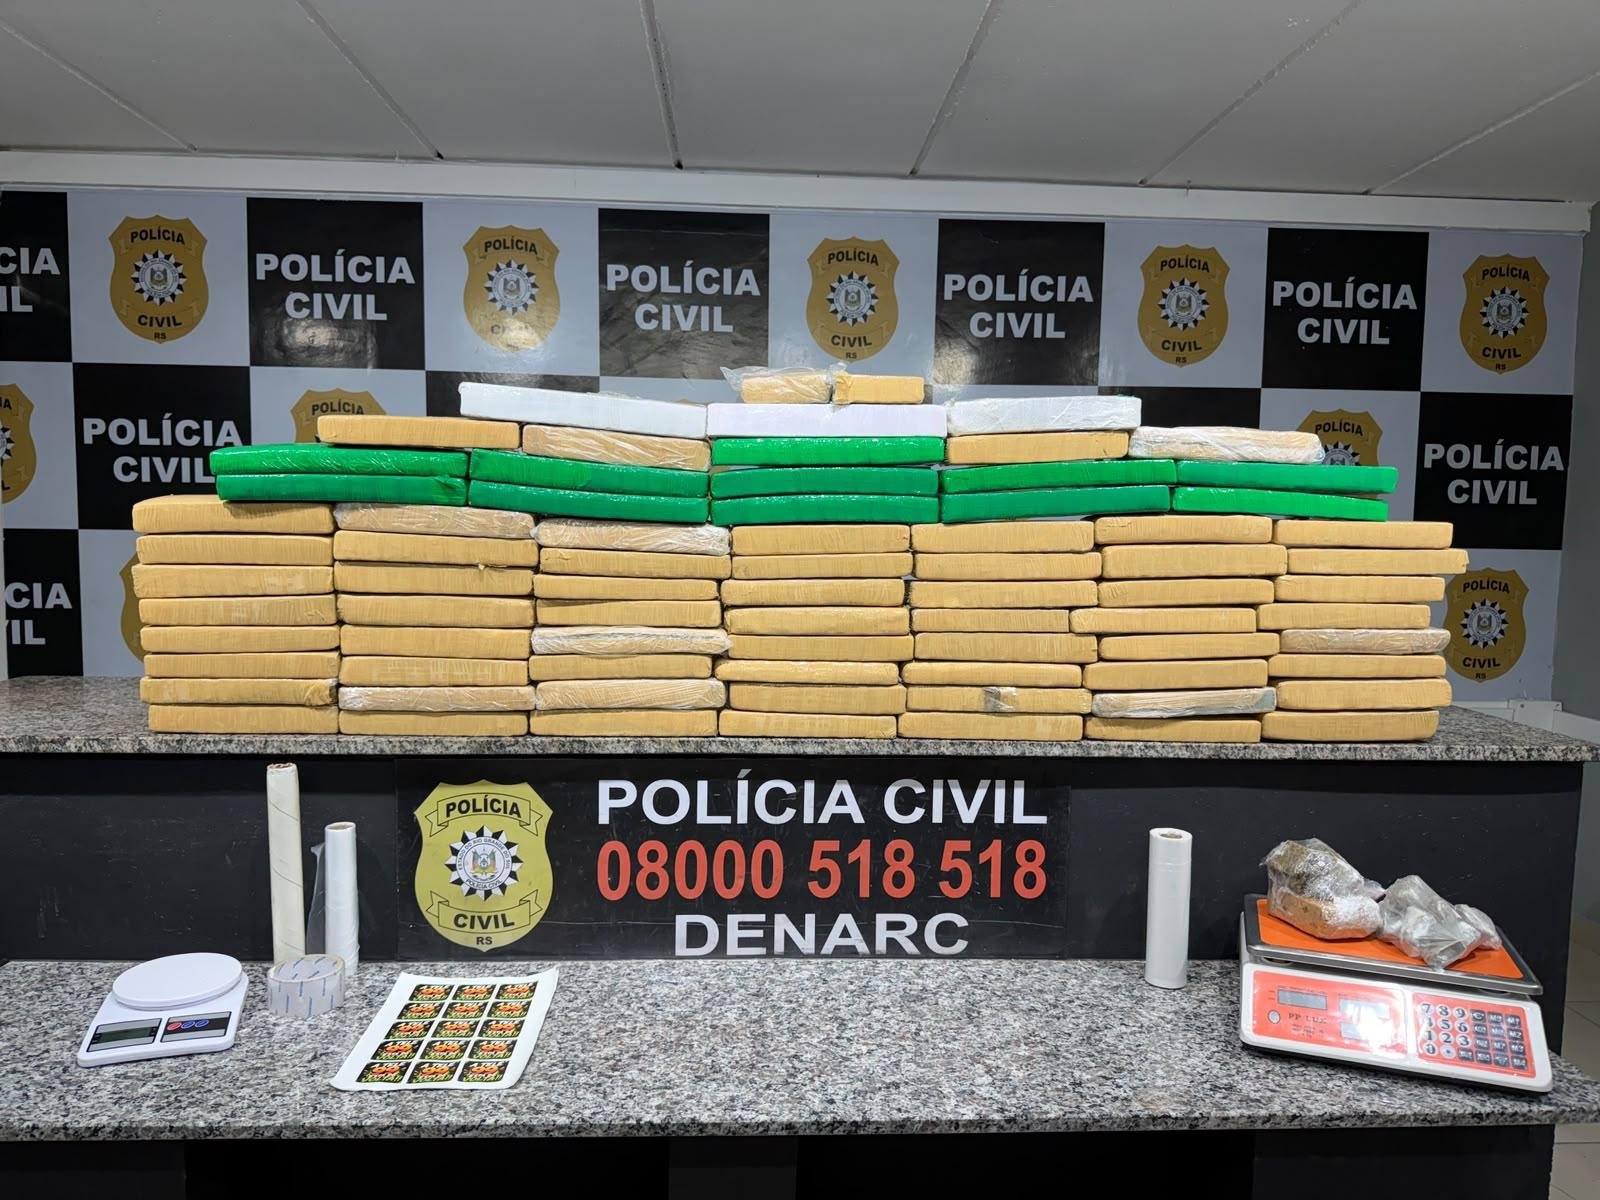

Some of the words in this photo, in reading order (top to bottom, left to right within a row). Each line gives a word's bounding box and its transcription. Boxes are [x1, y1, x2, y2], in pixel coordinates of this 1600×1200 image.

[130, 226, 185, 245] POLÍCIA
[484, 235, 537, 255] POLÍCIA
[827, 247, 879, 266] POLÍCIA
[1160, 255, 1210, 273] POLÍCIA
[255, 249, 416, 284] POLÍCIA
[1482, 266, 1531, 282] POLÍCIA
[606, 260, 761, 296] POLÍCIA
[943, 268, 1094, 303] POLÍCIA
[1272, 276, 1418, 310] POLÍCIA
[285, 292, 387, 320] CIVIL
[137, 314, 183, 328] CIVIL
[634, 303, 734, 333] CIVIL
[969, 312, 1066, 338] CIVIL
[831, 335, 873, 347] CIVIL
[1297, 318, 1390, 345] CIVIL
[1161, 340, 1202, 352] CIVIL
[1481, 347, 1522, 359] CIVIL
[311, 398, 365, 416] POLÍCIA
[82, 413, 243, 447] POLÍCIA
[1315, 418, 1364, 437] POLÍCIA
[1423, 438, 1565, 471] POLÍCIA
[1447, 479, 1538, 505] CIVIL
[1463, 577, 1510, 594] POLÍCIA
[1462, 657, 1501, 669] CIVIL
[445, 794, 522, 818] POLÍCIA
[598, 768, 865, 825] POLÍCIA
[884, 778, 1048, 825] CIVIL
[596, 839, 784, 900] 08000
[806, 839, 916, 900] 518
[938, 839, 1047, 900] 518
[453, 912, 515, 930] CIVIL
[476, 936, 493, 946] RS
[674, 912, 969, 956] DENARC
[1421, 1003, 1431, 1013] 7
[1439, 1005, 1449, 1016] 8
[1455, 1008, 1465, 1018] 9
[1440, 1019, 1450, 1029] 5
[1457, 1022, 1468, 1032] 6
[1425, 1030, 1432, 1040] 1
[1441, 1033, 1452, 1043] 2
[1459, 1035, 1469, 1046] 3
